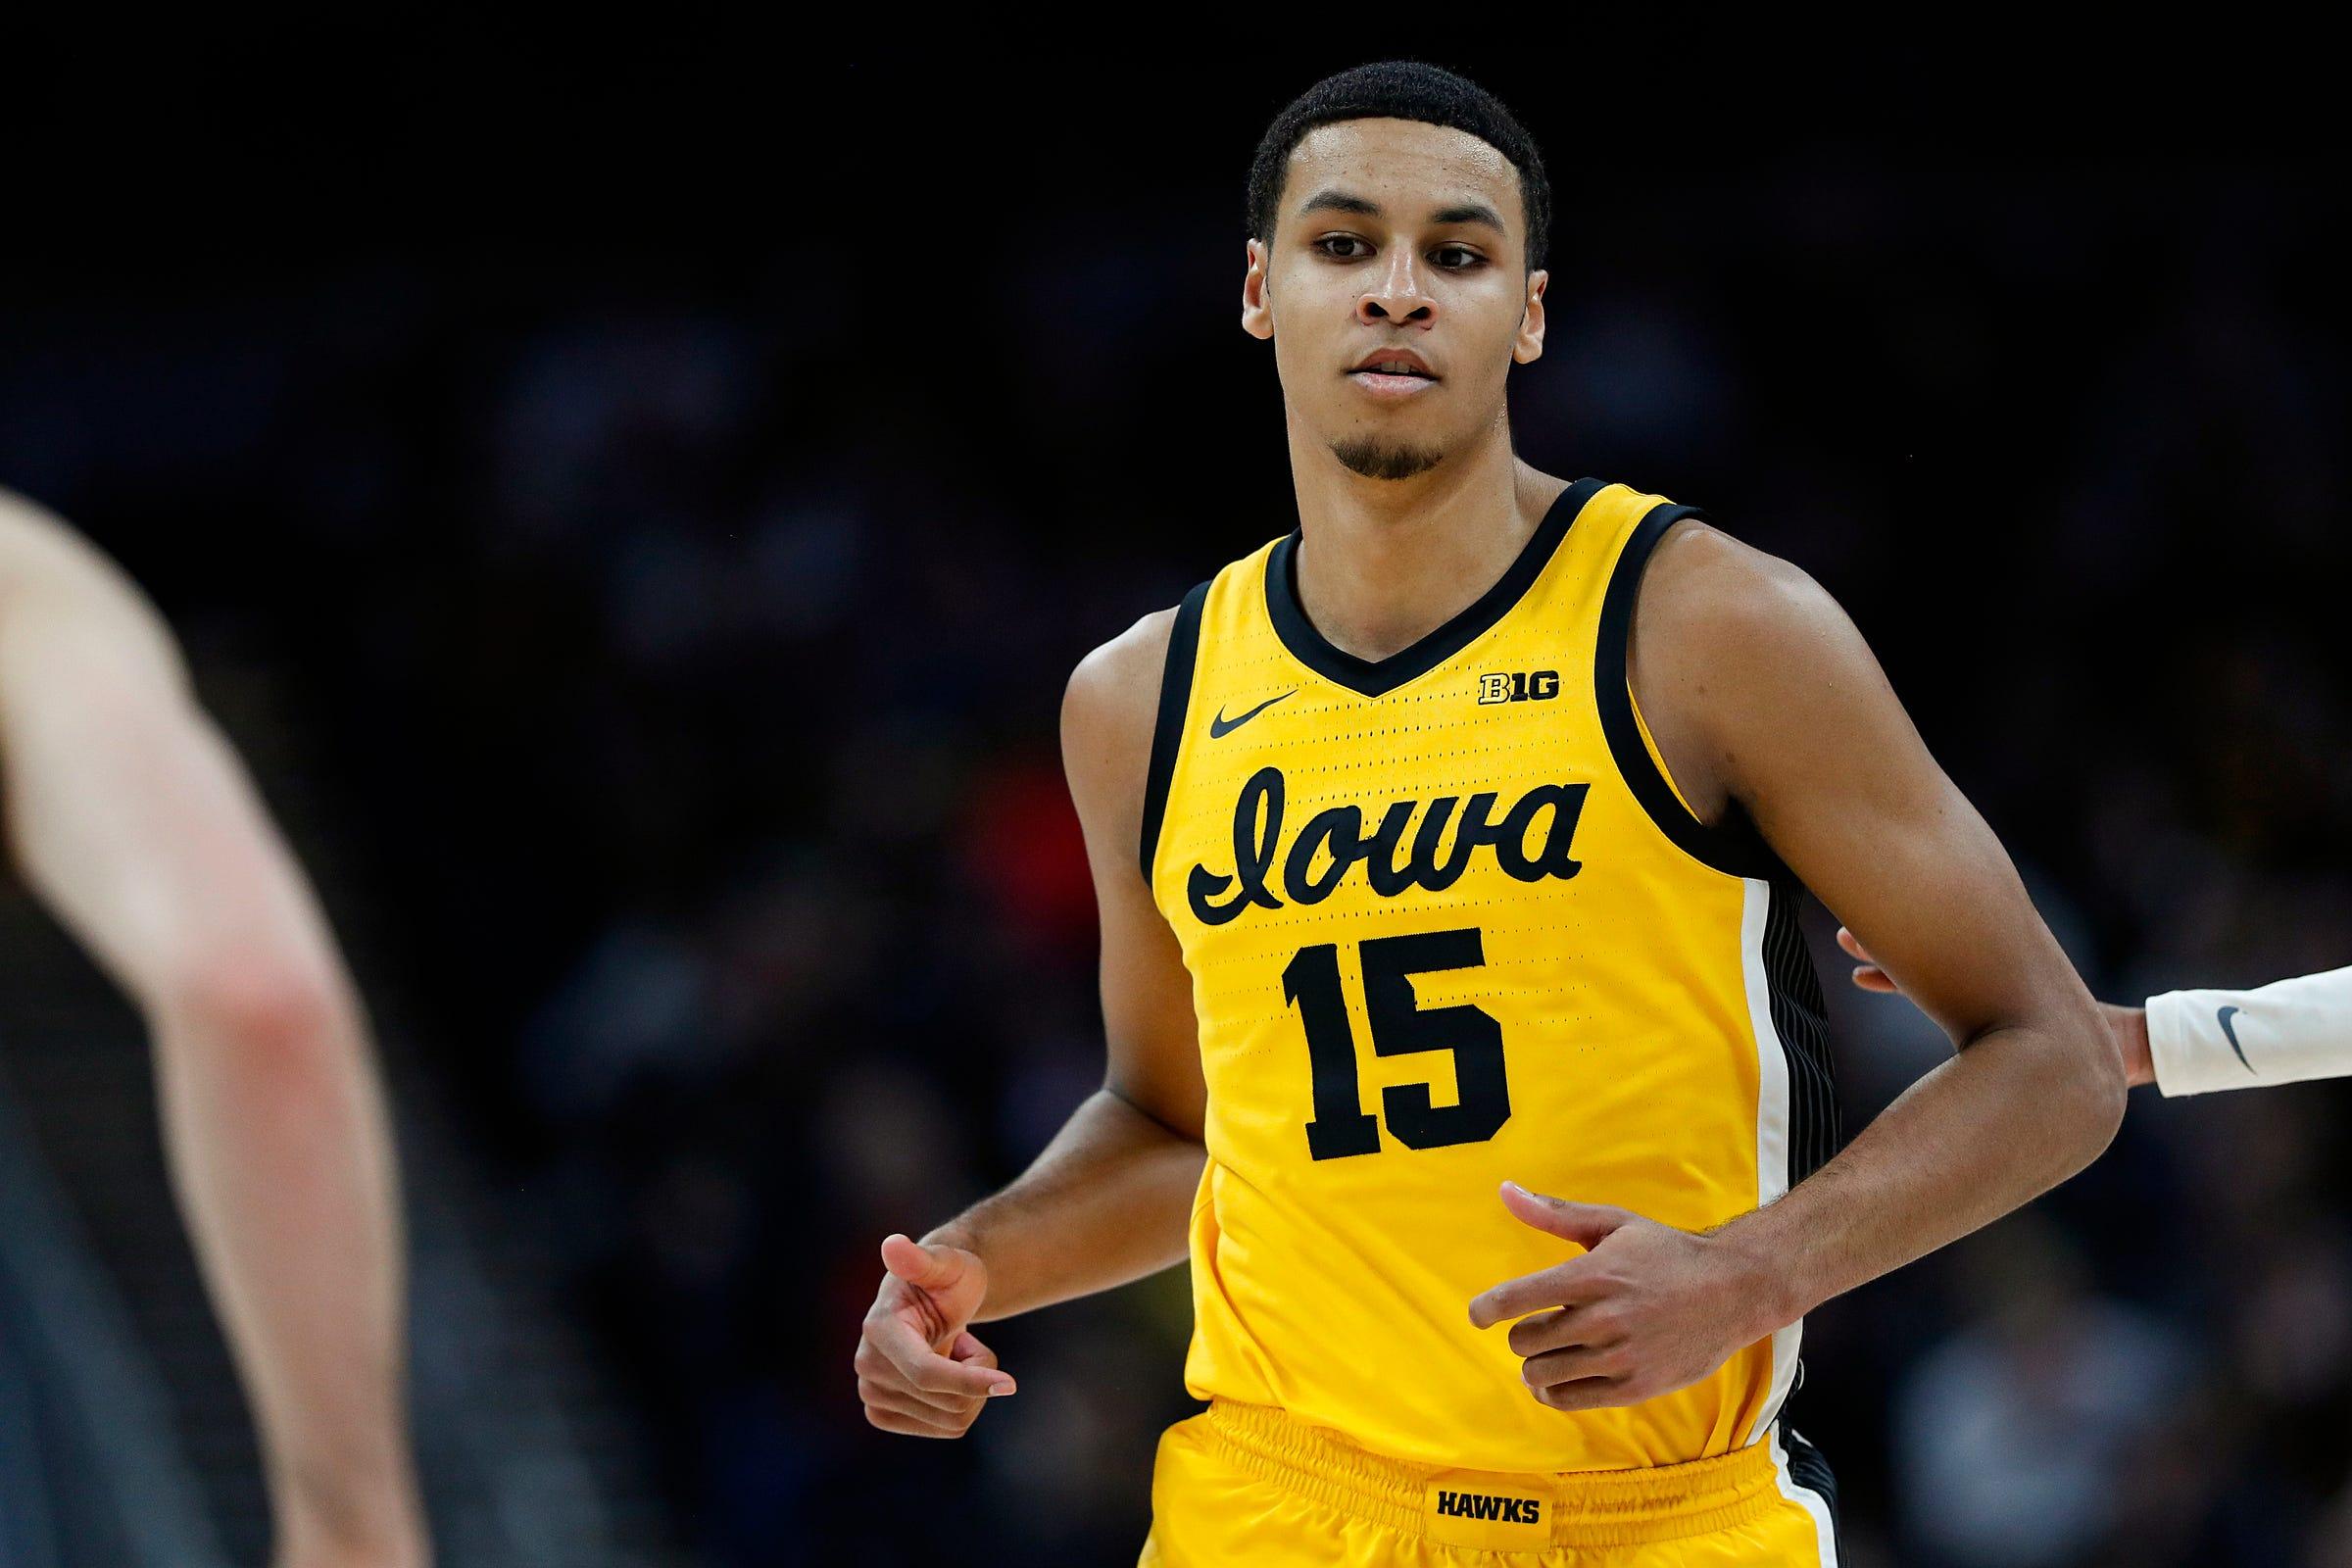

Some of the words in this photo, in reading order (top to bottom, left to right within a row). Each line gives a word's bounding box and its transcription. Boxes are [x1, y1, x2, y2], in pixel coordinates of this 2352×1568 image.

[1187, 767, 1591, 925] Iowa
[1282, 927, 1512, 1161] 15
[1438, 1491, 1540, 1524] HAWKS
